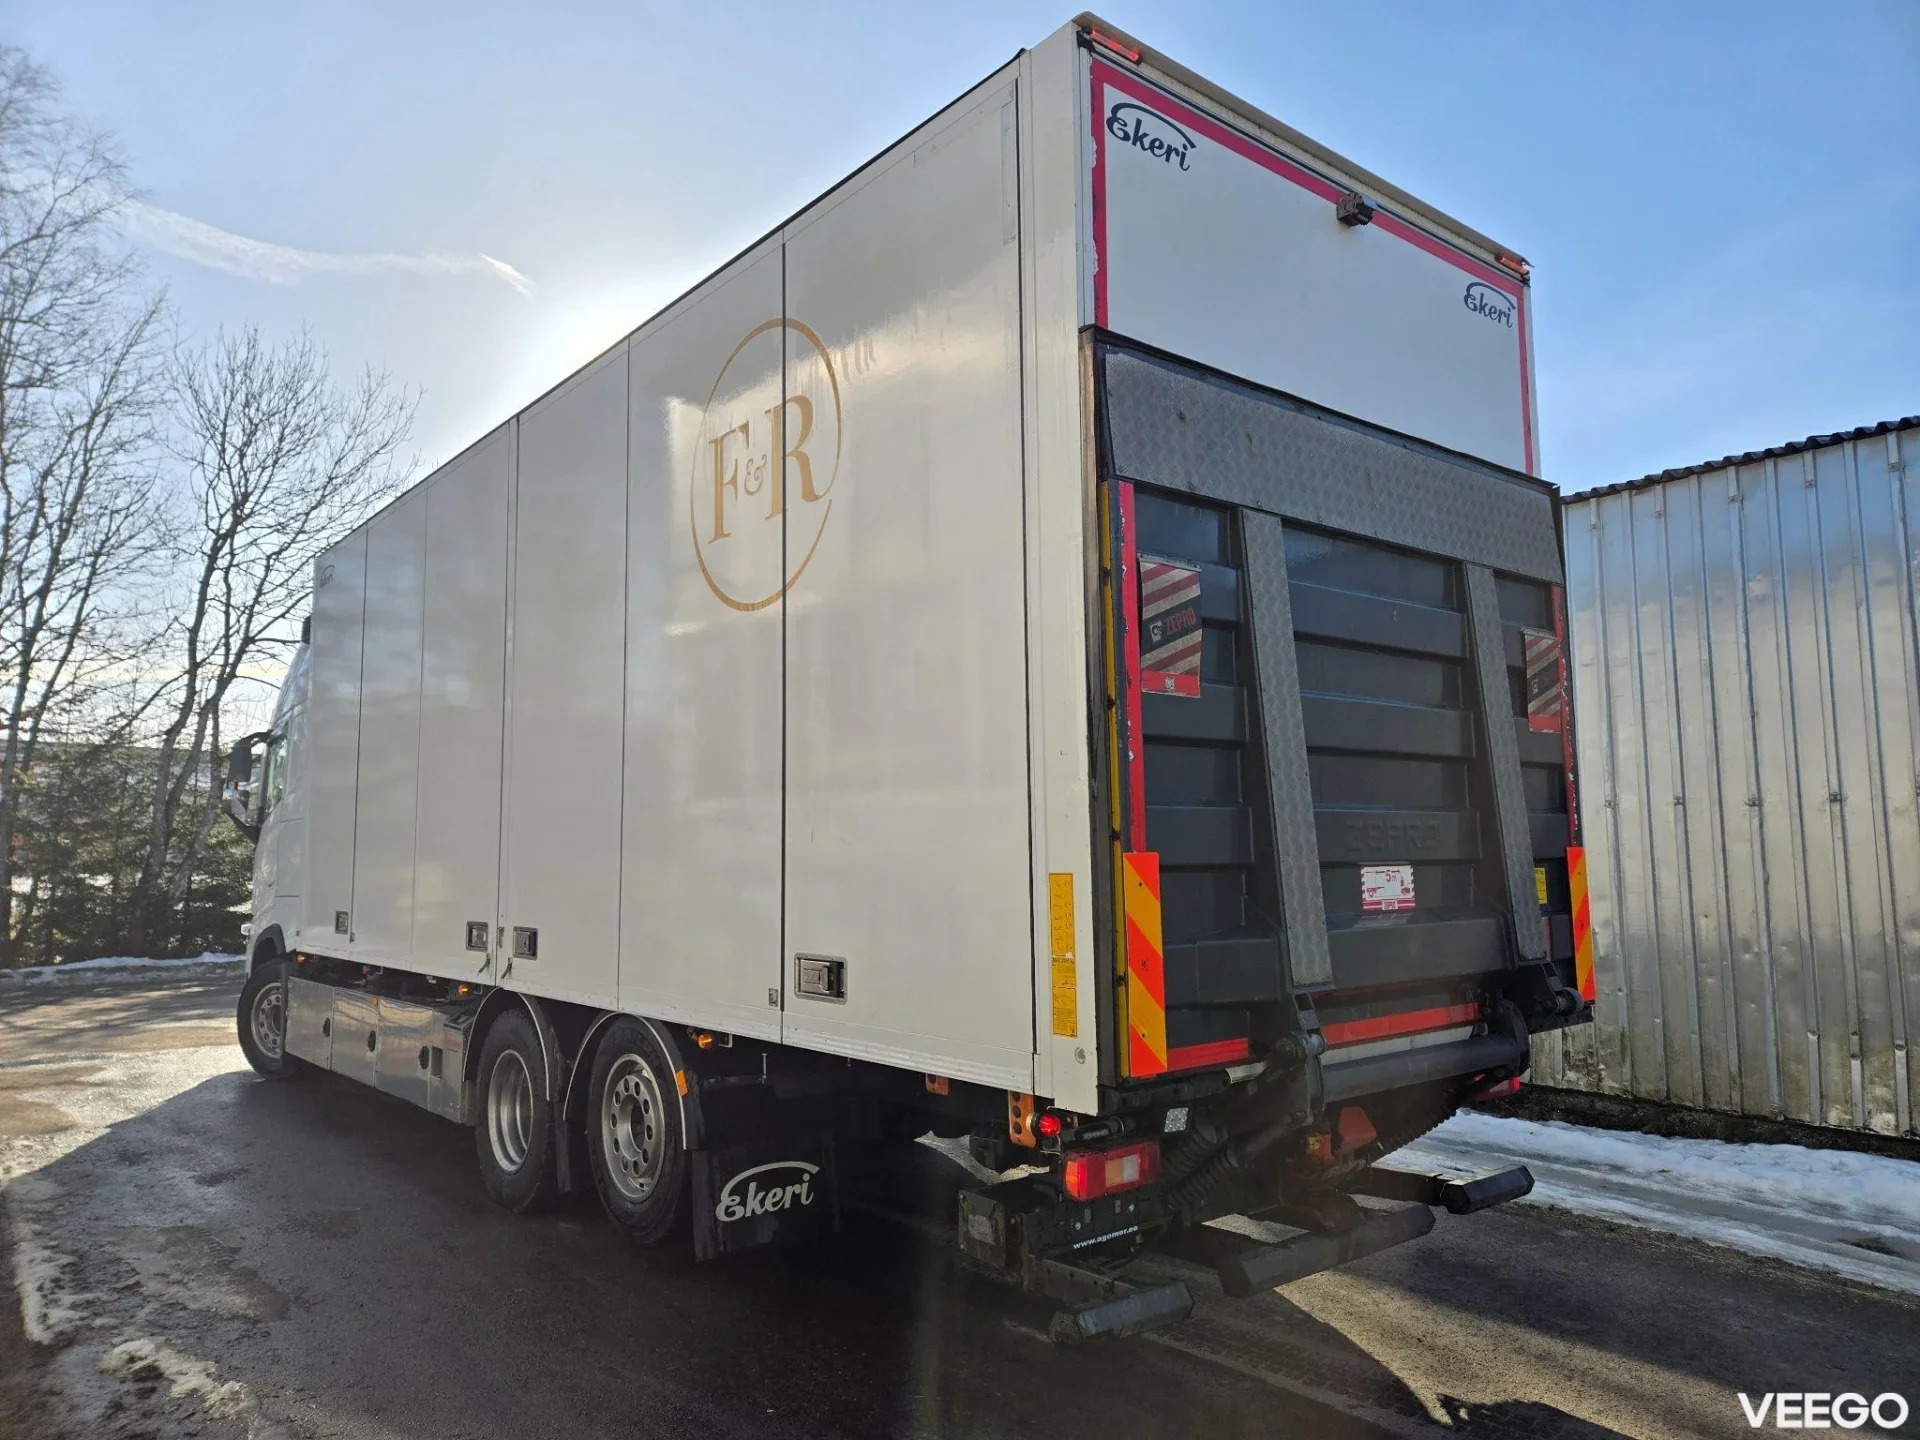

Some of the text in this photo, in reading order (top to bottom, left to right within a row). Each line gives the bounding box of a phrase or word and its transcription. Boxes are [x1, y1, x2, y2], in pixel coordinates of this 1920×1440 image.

[1106, 102, 1197, 171] Ekeri
[1464, 282, 1516, 328] Ekeri
[1164, 607, 1197, 635] ZEPRO
[715, 1161, 820, 1222] Ekeri
[1073, 1225, 1138, 1250] www.agomer.ee
